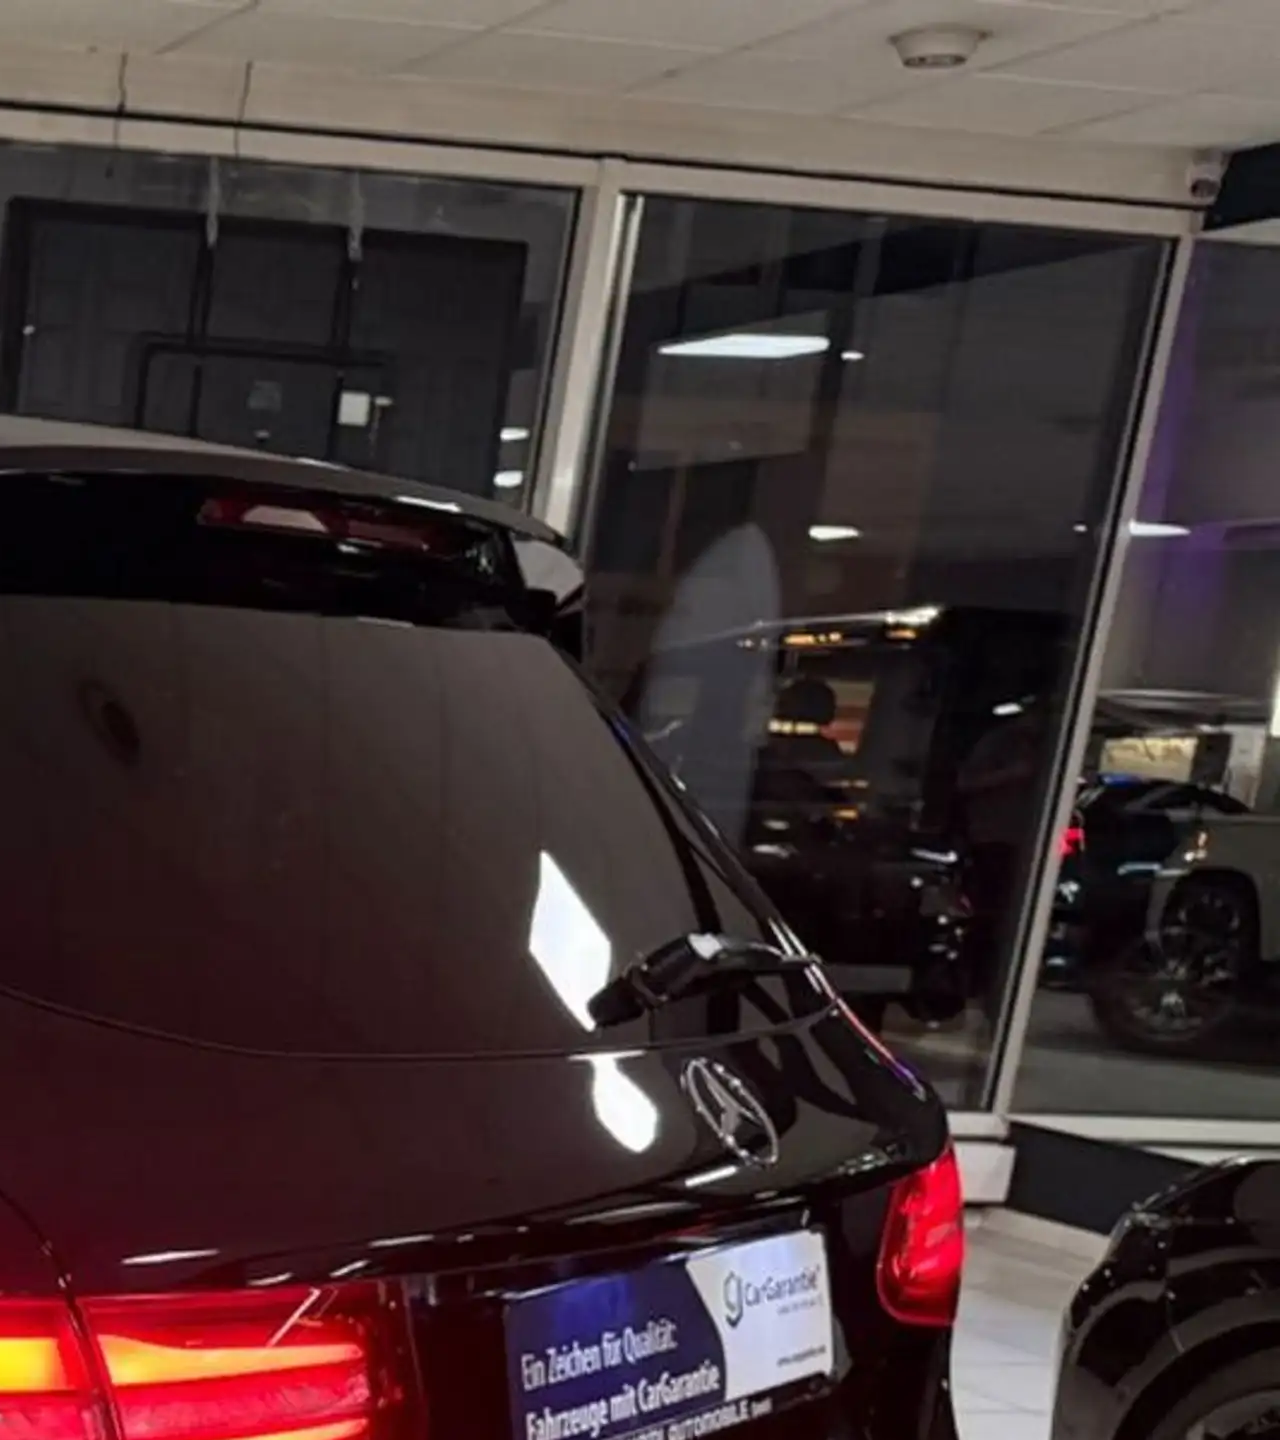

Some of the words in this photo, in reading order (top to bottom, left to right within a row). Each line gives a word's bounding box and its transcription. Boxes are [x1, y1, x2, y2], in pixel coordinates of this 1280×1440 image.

[521, 1354, 546, 1391] Ein
[546, 1341, 601, 1383] Zeichen
[602, 1331, 623, 1367] für
[610, 1384, 636, 1421] mit
[638, 1360, 719, 1412] CarGarantie
